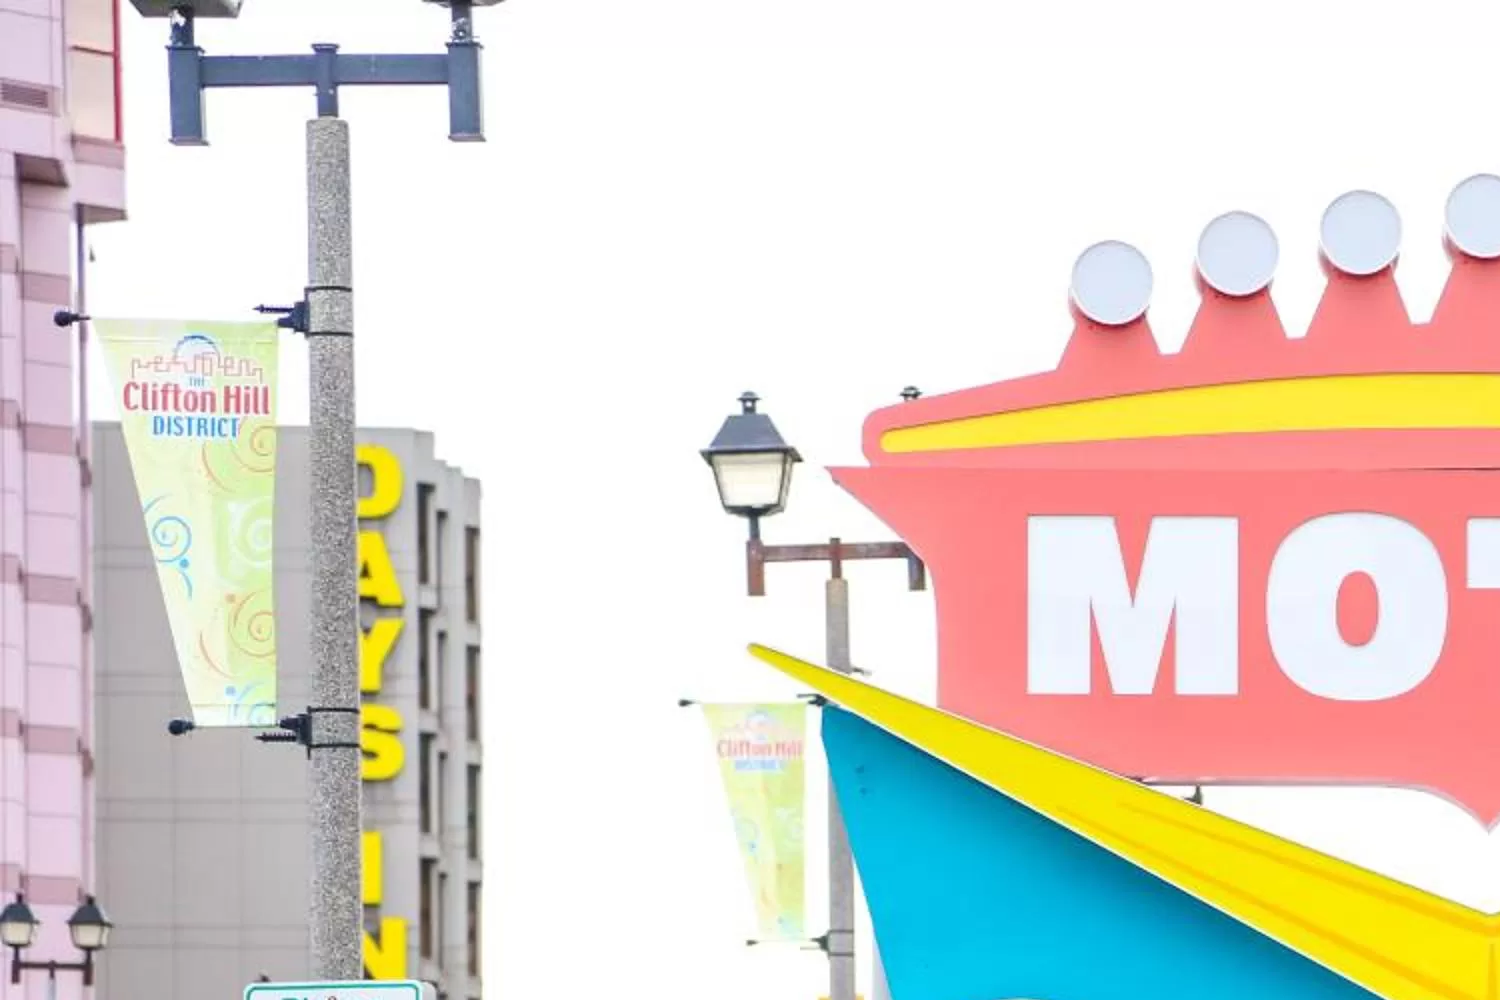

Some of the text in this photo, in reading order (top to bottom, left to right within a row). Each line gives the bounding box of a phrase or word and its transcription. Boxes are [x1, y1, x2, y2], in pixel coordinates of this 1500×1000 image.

[123, 381, 270, 415] Clifton Hill
[152, 415, 240, 438] DISTRICT
